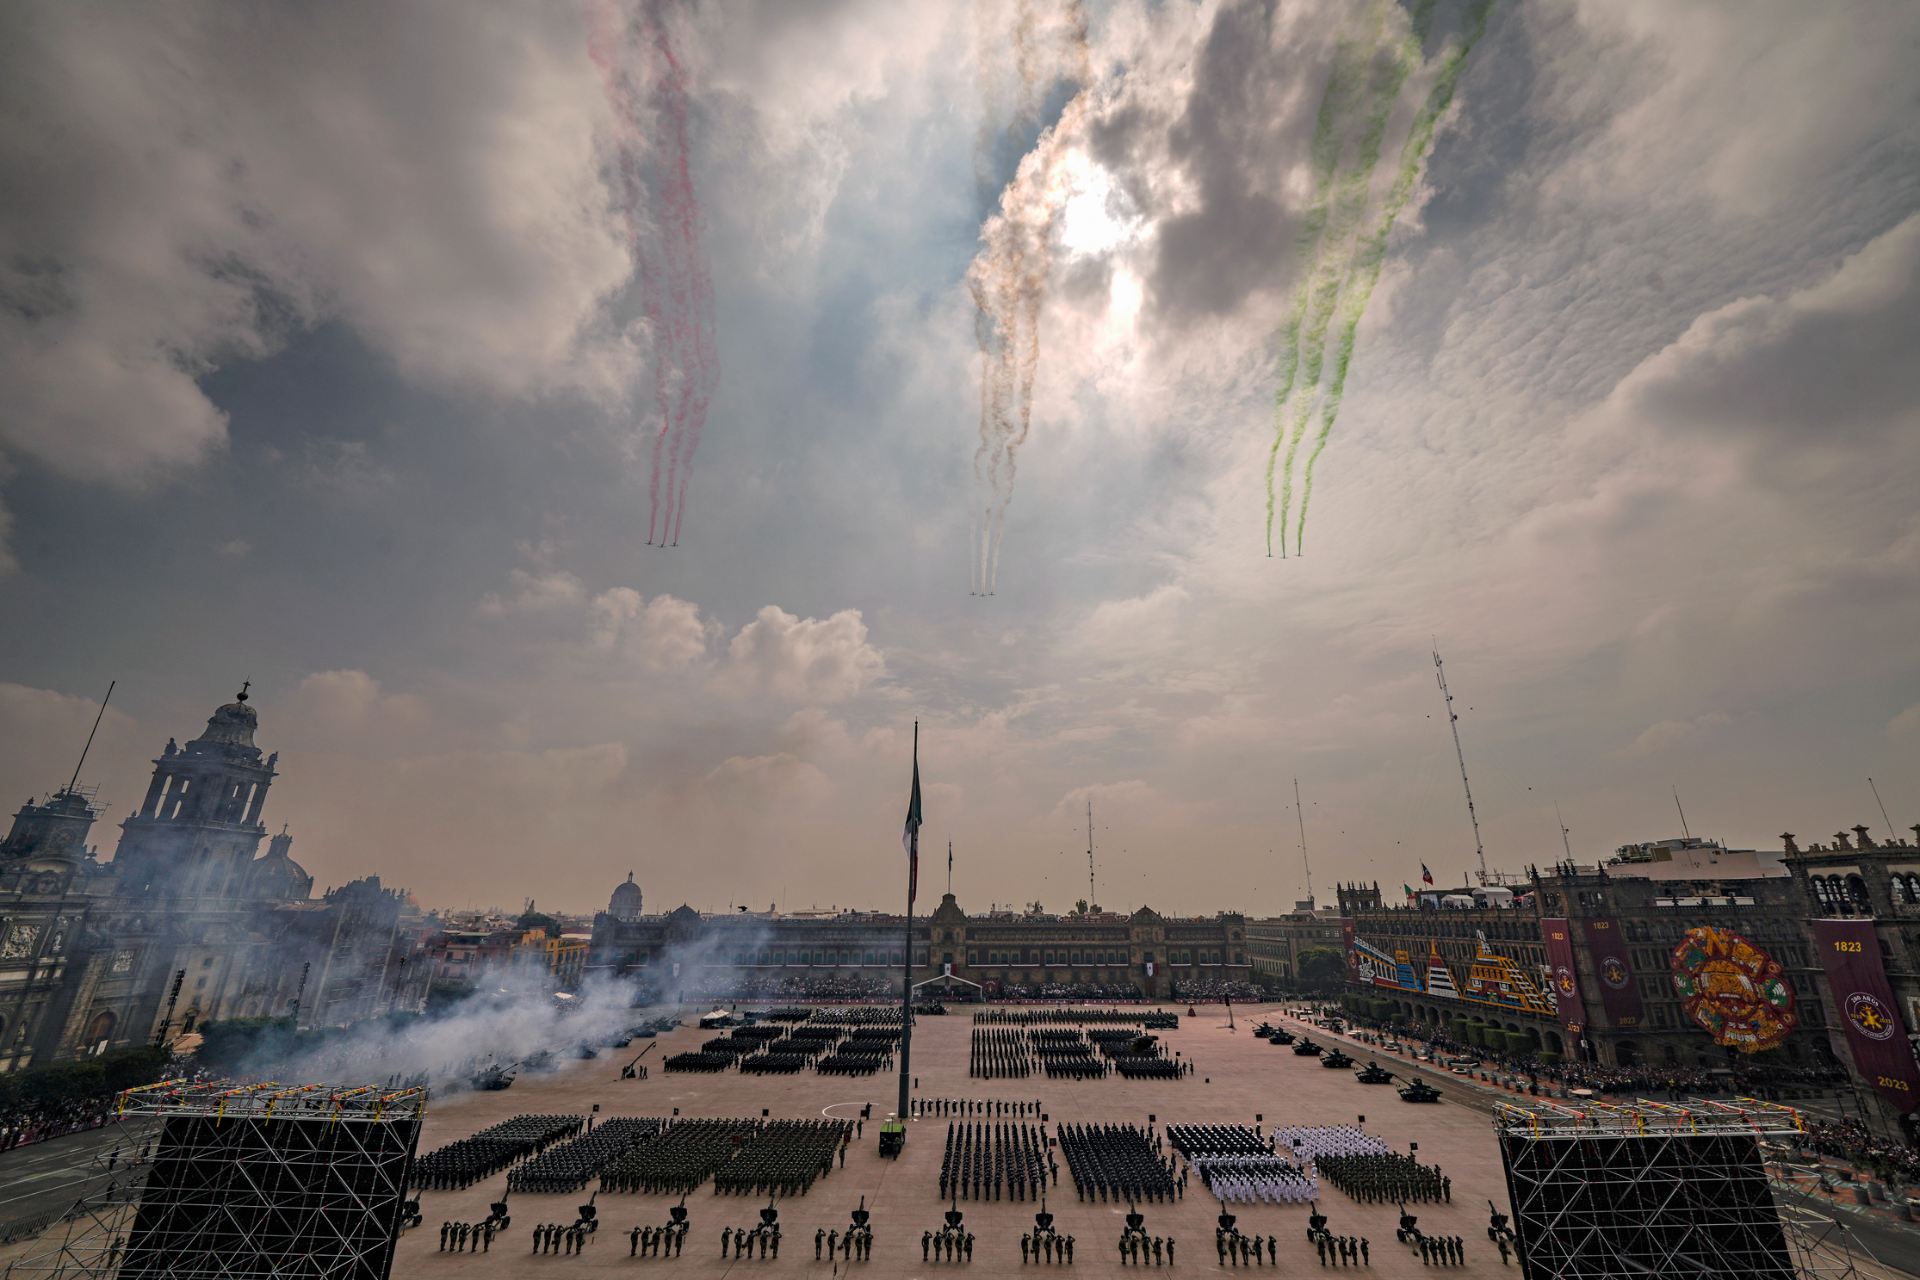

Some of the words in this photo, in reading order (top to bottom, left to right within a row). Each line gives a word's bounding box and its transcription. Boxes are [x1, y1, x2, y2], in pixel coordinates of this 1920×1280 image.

[1594, 921, 1609, 929] 1823
[1834, 941, 1861, 952] 1823
[1877, 1075, 1909, 1091] 2023
